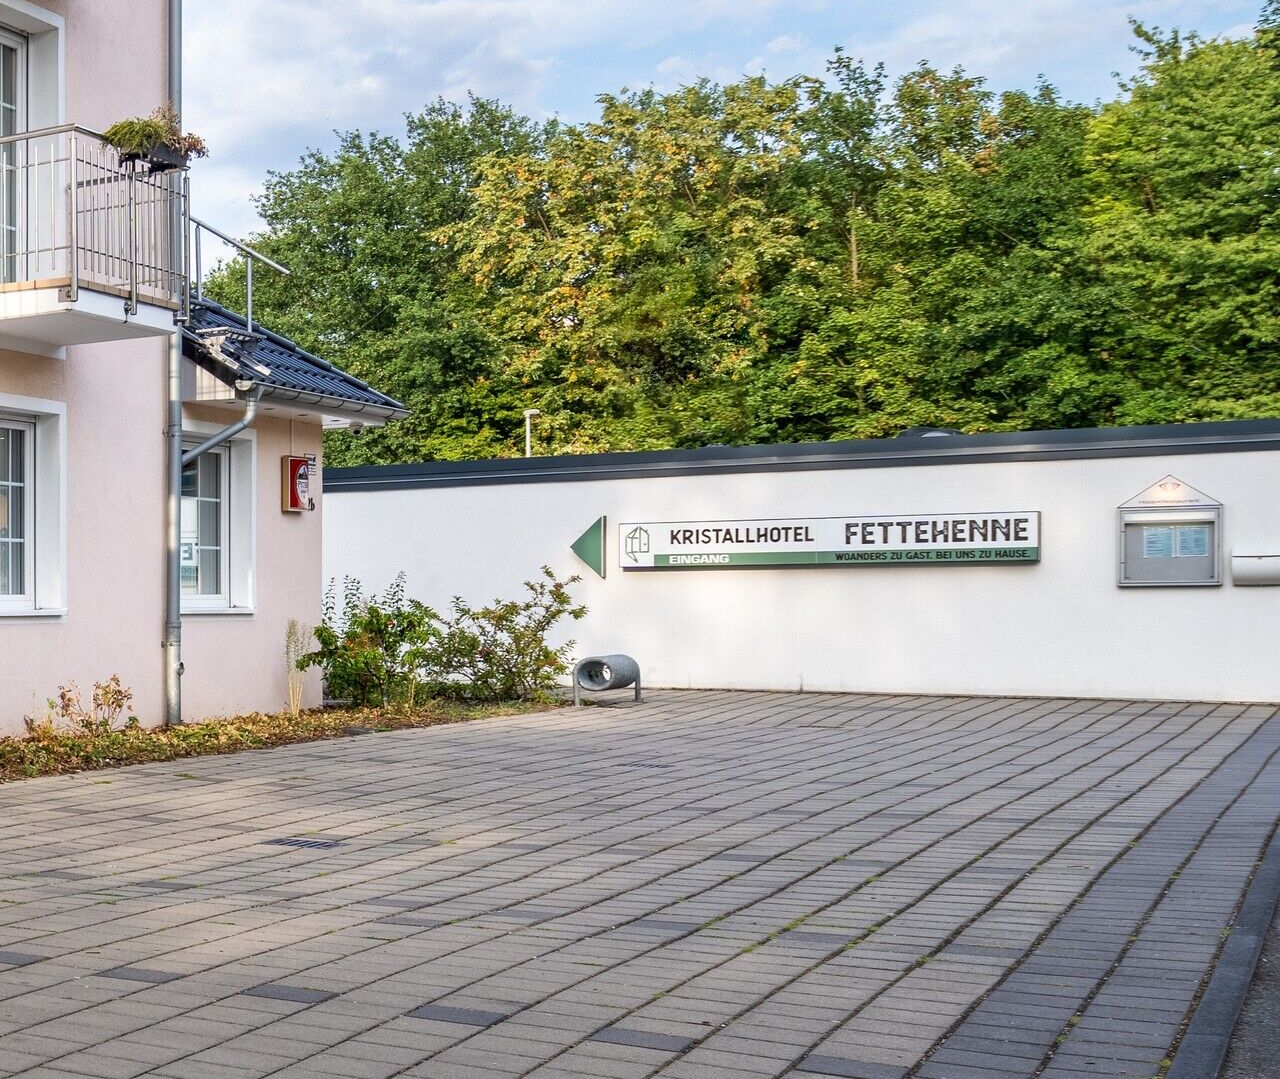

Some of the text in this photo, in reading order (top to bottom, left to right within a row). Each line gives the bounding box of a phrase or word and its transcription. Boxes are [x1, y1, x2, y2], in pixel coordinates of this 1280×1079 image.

[670, 518, 1029, 545] KRISTALLHOTEL FETTEHENNE
[669, 554, 730, 564] EINGANG
[835, 549, 1031, 561] WOANDERS ZU GAST. BEI UNS ZU HAUSE.
